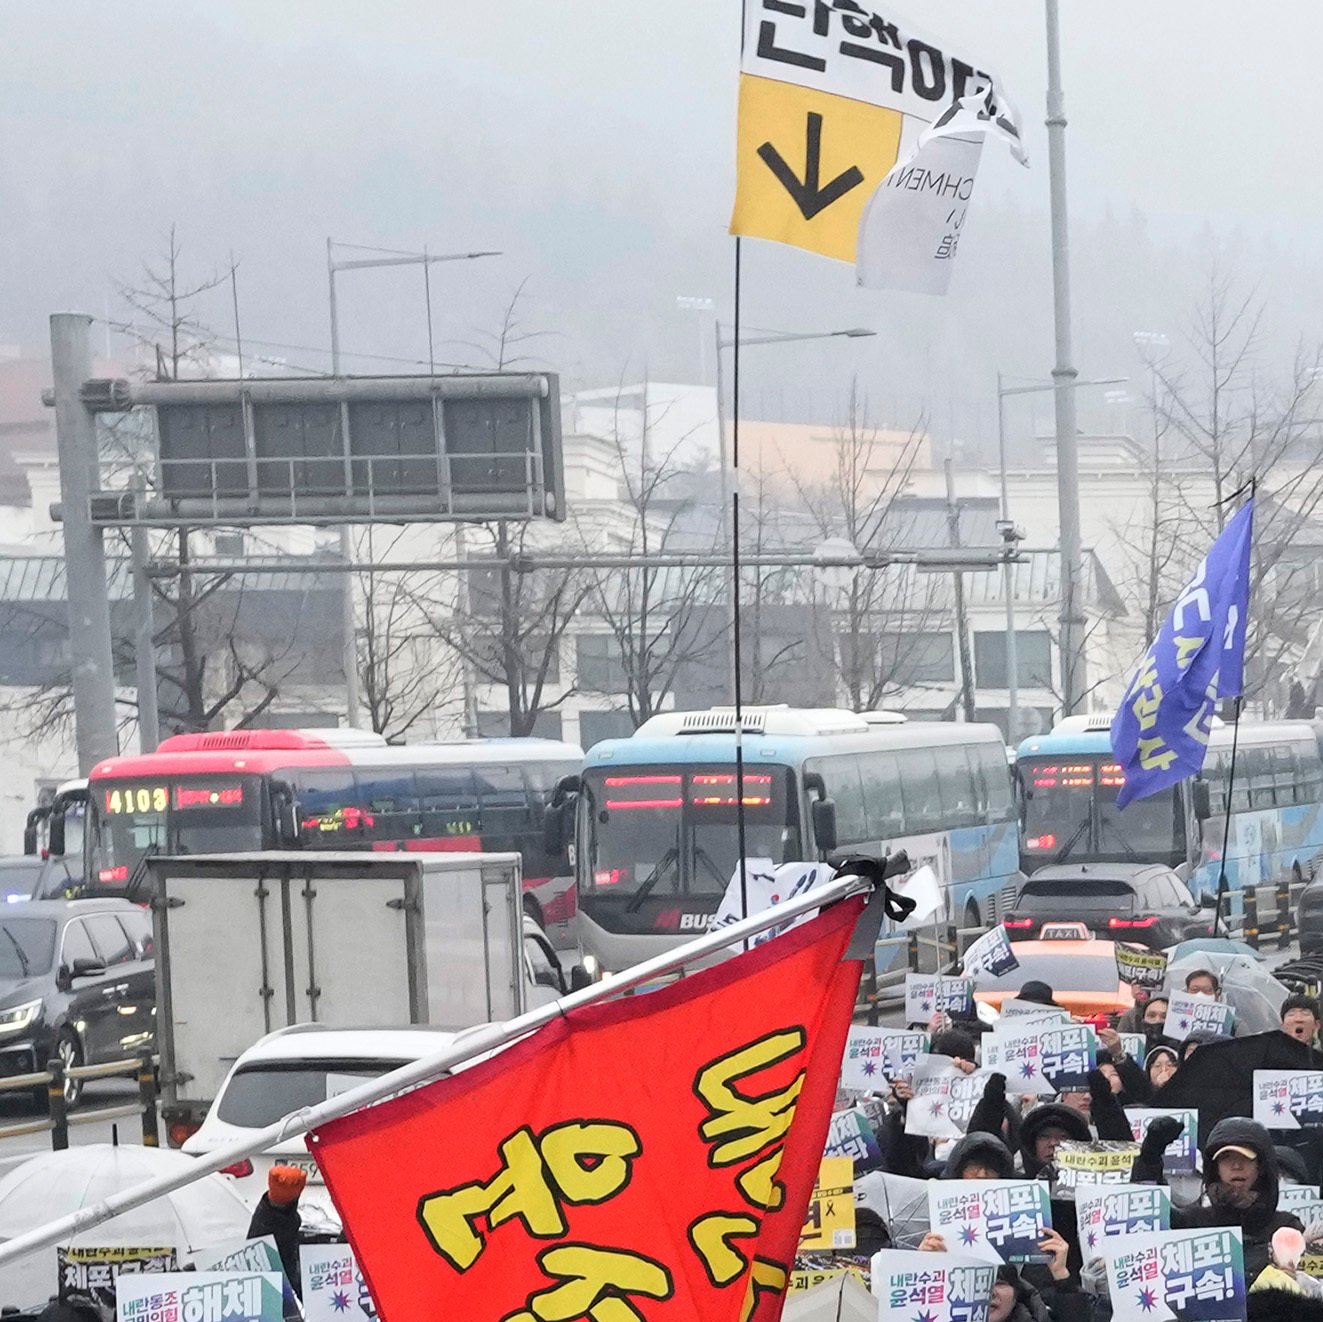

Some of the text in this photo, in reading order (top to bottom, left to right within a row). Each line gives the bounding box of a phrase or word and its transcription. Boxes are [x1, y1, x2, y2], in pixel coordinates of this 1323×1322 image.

[1047, 929, 1079, 939] TAXI
[1039, 1027, 1088, 1056] 체포!
[983, 1184, 1042, 1216] 체포!
[890, 1270, 946, 1289] 내란수괴
[890, 1285, 946, 1307] 윤석열
